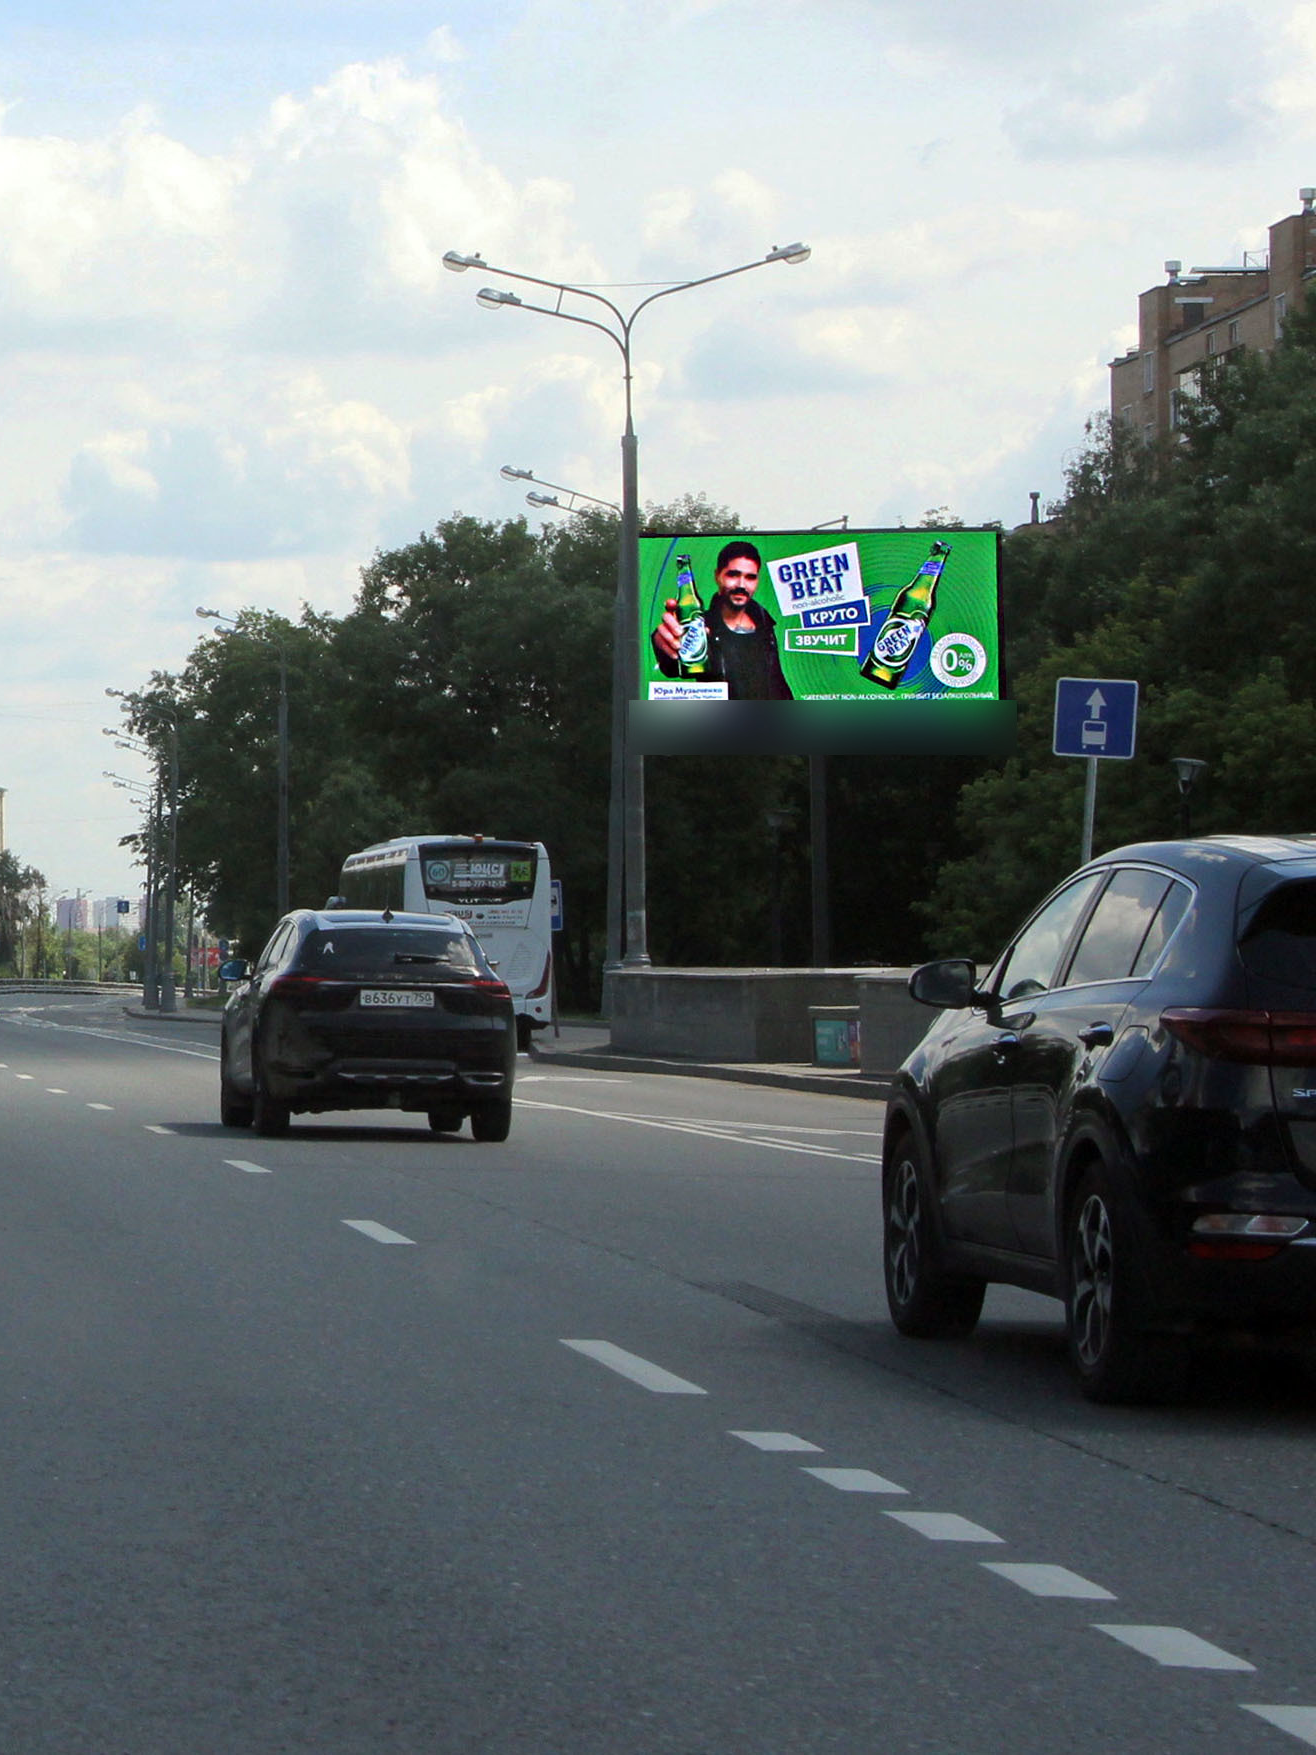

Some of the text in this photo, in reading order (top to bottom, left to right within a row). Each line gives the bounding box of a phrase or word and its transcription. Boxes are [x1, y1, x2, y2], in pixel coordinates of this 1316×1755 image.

[777, 552, 850, 584] GREEN
[789, 573, 844, 601] BEAT
[792, 593, 846, 610] non-alcoholic
[809, 607, 859, 625] КРУТО
[795, 634, 848, 647] ЗВУЧИТ
[876, 625, 912, 653] GREEN
[887, 637, 913, 657] BEAT
[653, 687, 674, 696] Юра
[364, 991, 430, 1005] В636УТ 750
